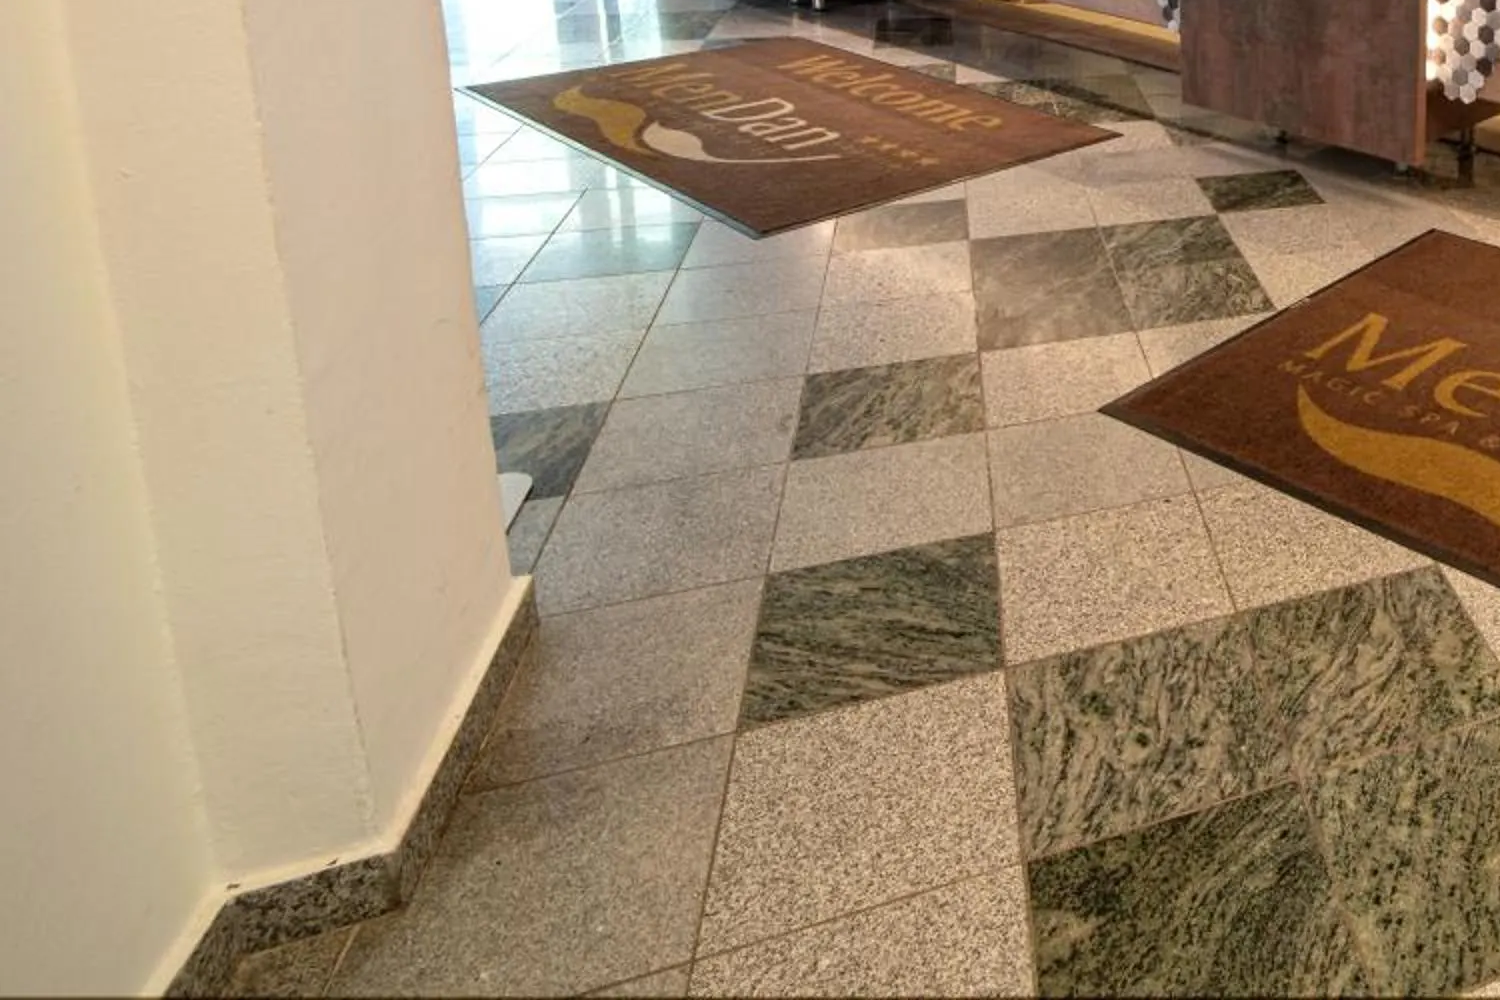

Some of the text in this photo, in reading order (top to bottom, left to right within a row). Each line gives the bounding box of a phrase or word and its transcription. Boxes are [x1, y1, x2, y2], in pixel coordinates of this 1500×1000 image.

[609, 63, 841, 150] MenDan
[776, 54, 1003, 132] Welcome
[1277, 358, 1383, 406] MAGIC
[1400, 403, 1462, 437] SPA
